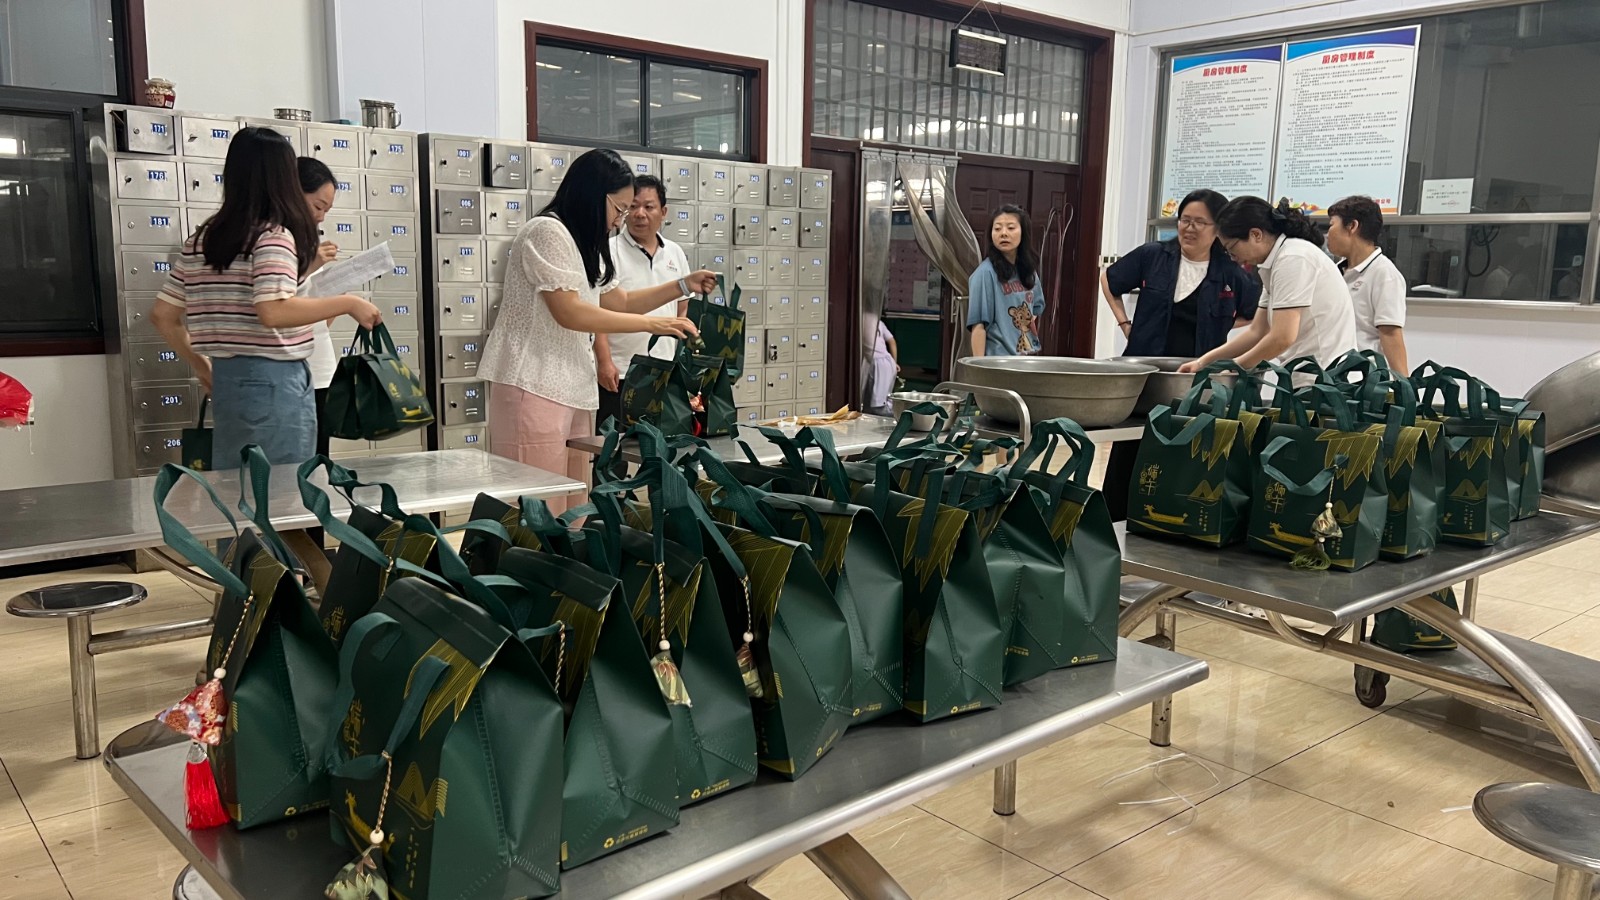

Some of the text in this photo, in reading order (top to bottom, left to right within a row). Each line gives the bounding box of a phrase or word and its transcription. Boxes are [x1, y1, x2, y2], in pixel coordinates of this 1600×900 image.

[1322, 50, 1375, 64] 厨房管理制度
[1203, 65, 1247, 77] 厨房管理制度
[153, 124, 165, 134] 171
[214, 130, 227, 138] 172
[335, 140, 347, 148] 174
[390, 145, 403, 153] 175
[150, 172, 165, 180] 176
[337, 183, 349, 191] 179
[392, 186, 403, 194] 180
[507, 202, 518, 210] 007
[152, 217, 167, 226] 181
[338, 224, 350, 232] 184
[394, 226, 405, 234] 185
[461, 248, 472, 256] 011
[156, 262, 170, 271] 186
[395, 266, 406, 274] 190
[160, 352, 175, 360] 196
[165, 396, 178, 404] 201
